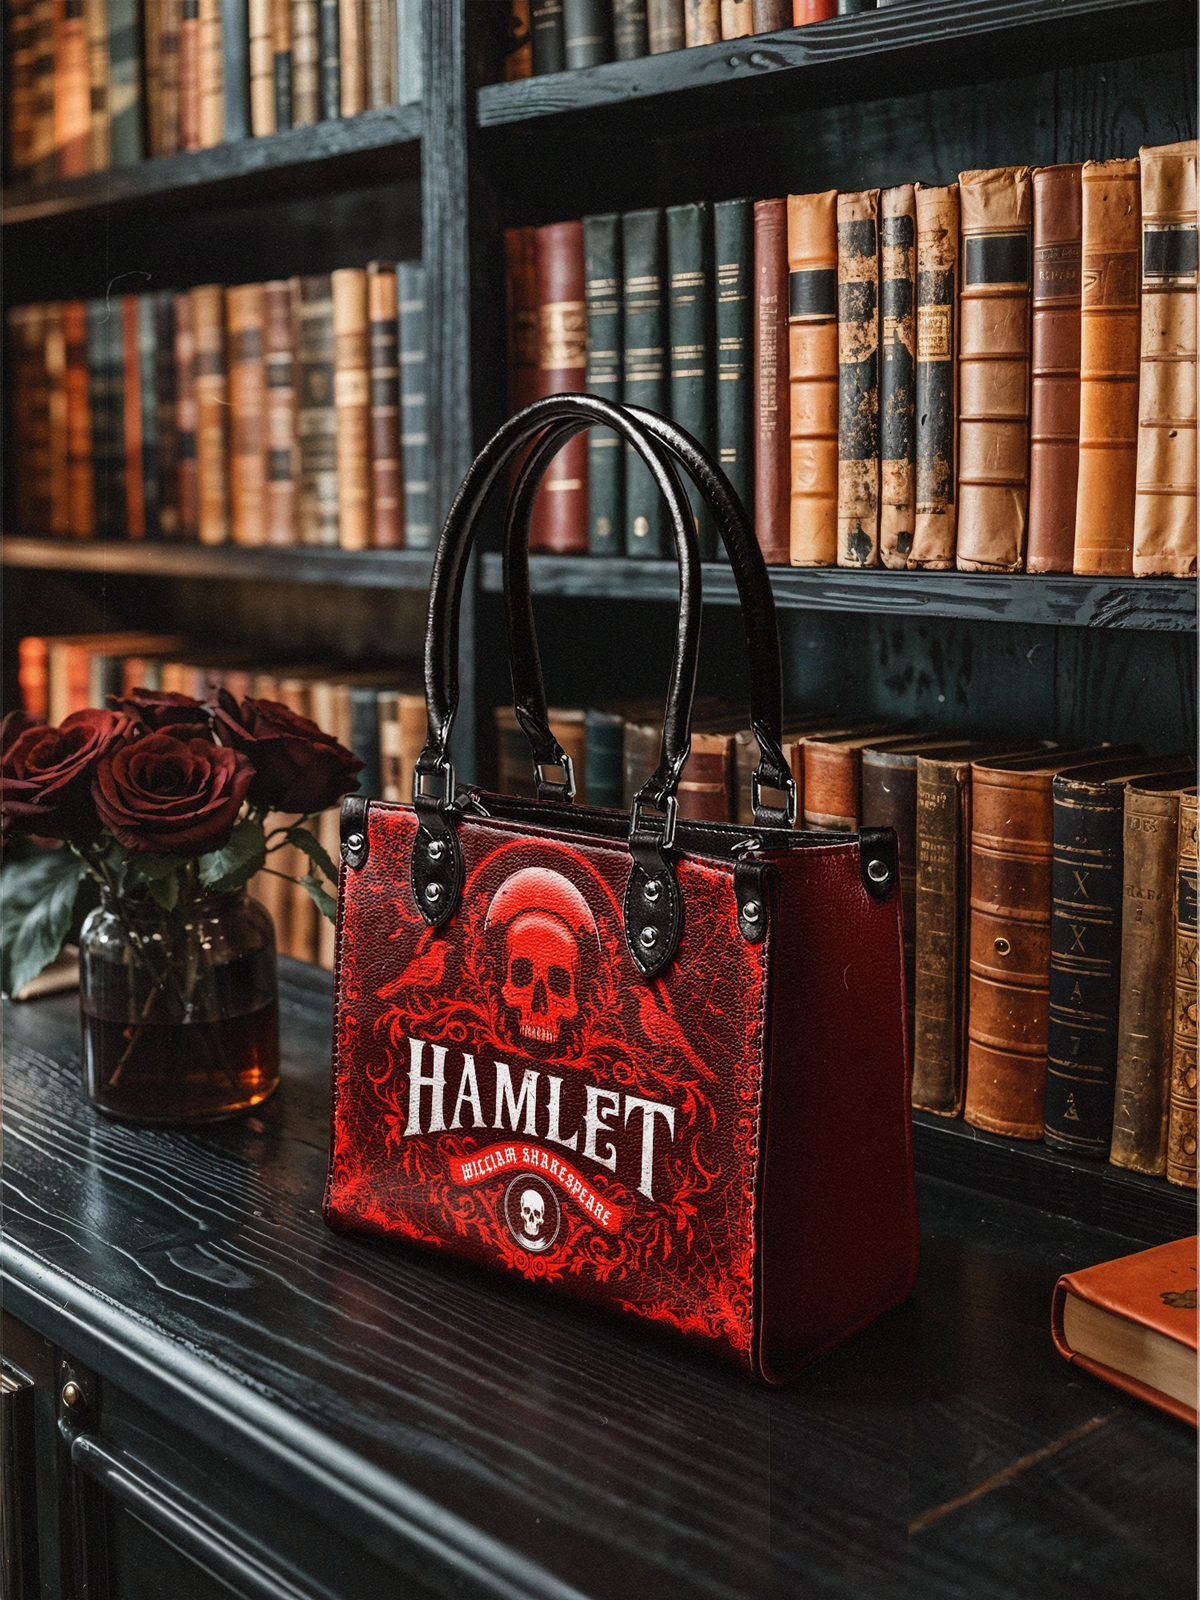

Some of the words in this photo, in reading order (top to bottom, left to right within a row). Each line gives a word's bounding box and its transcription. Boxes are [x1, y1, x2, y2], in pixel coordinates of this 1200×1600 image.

[402, 1036, 678, 1202] HAMLET
[461, 1146, 518, 1182] WILLIAM
[522, 1147, 613, 1227] SHAKESPEARE
